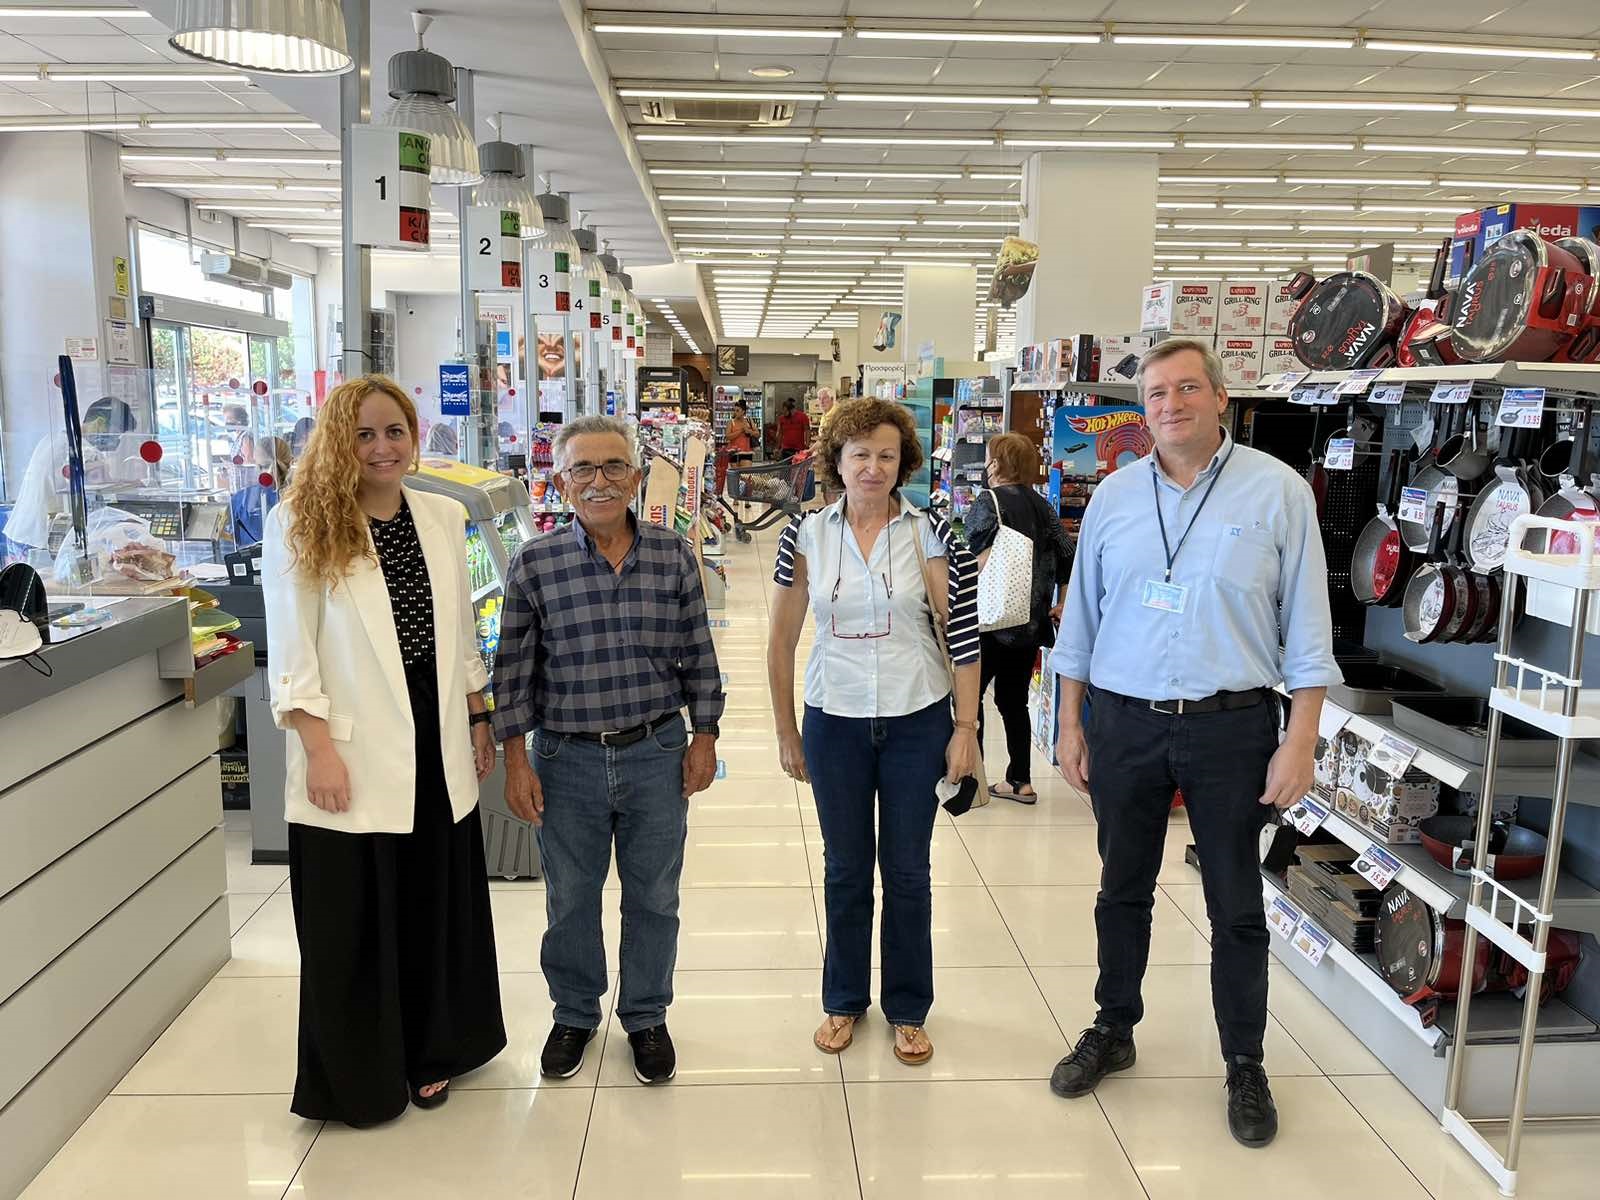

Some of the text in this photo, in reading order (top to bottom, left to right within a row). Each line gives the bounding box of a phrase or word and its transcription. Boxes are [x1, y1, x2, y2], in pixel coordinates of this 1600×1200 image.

[375, 175, 387, 201] 1
[479, 237, 492, 256] 2
[538, 274, 549, 288] 3
[574, 299, 584, 310] 4
[1176, 296, 1213, 306] GRILL-KING
[1223, 296, 1260, 306] GRILL-KING
[1456, 282, 1477, 328] NAVA
[602, 315, 610, 325] 5
[1344, 322, 1376, 358] NAVA
[1220, 350, 1256, 360] GRILL-KING
[1088, 417, 1108, 433] HOT
[1497, 489, 1520, 502] NAVA
[1387, 889, 1410, 914] NAVA
